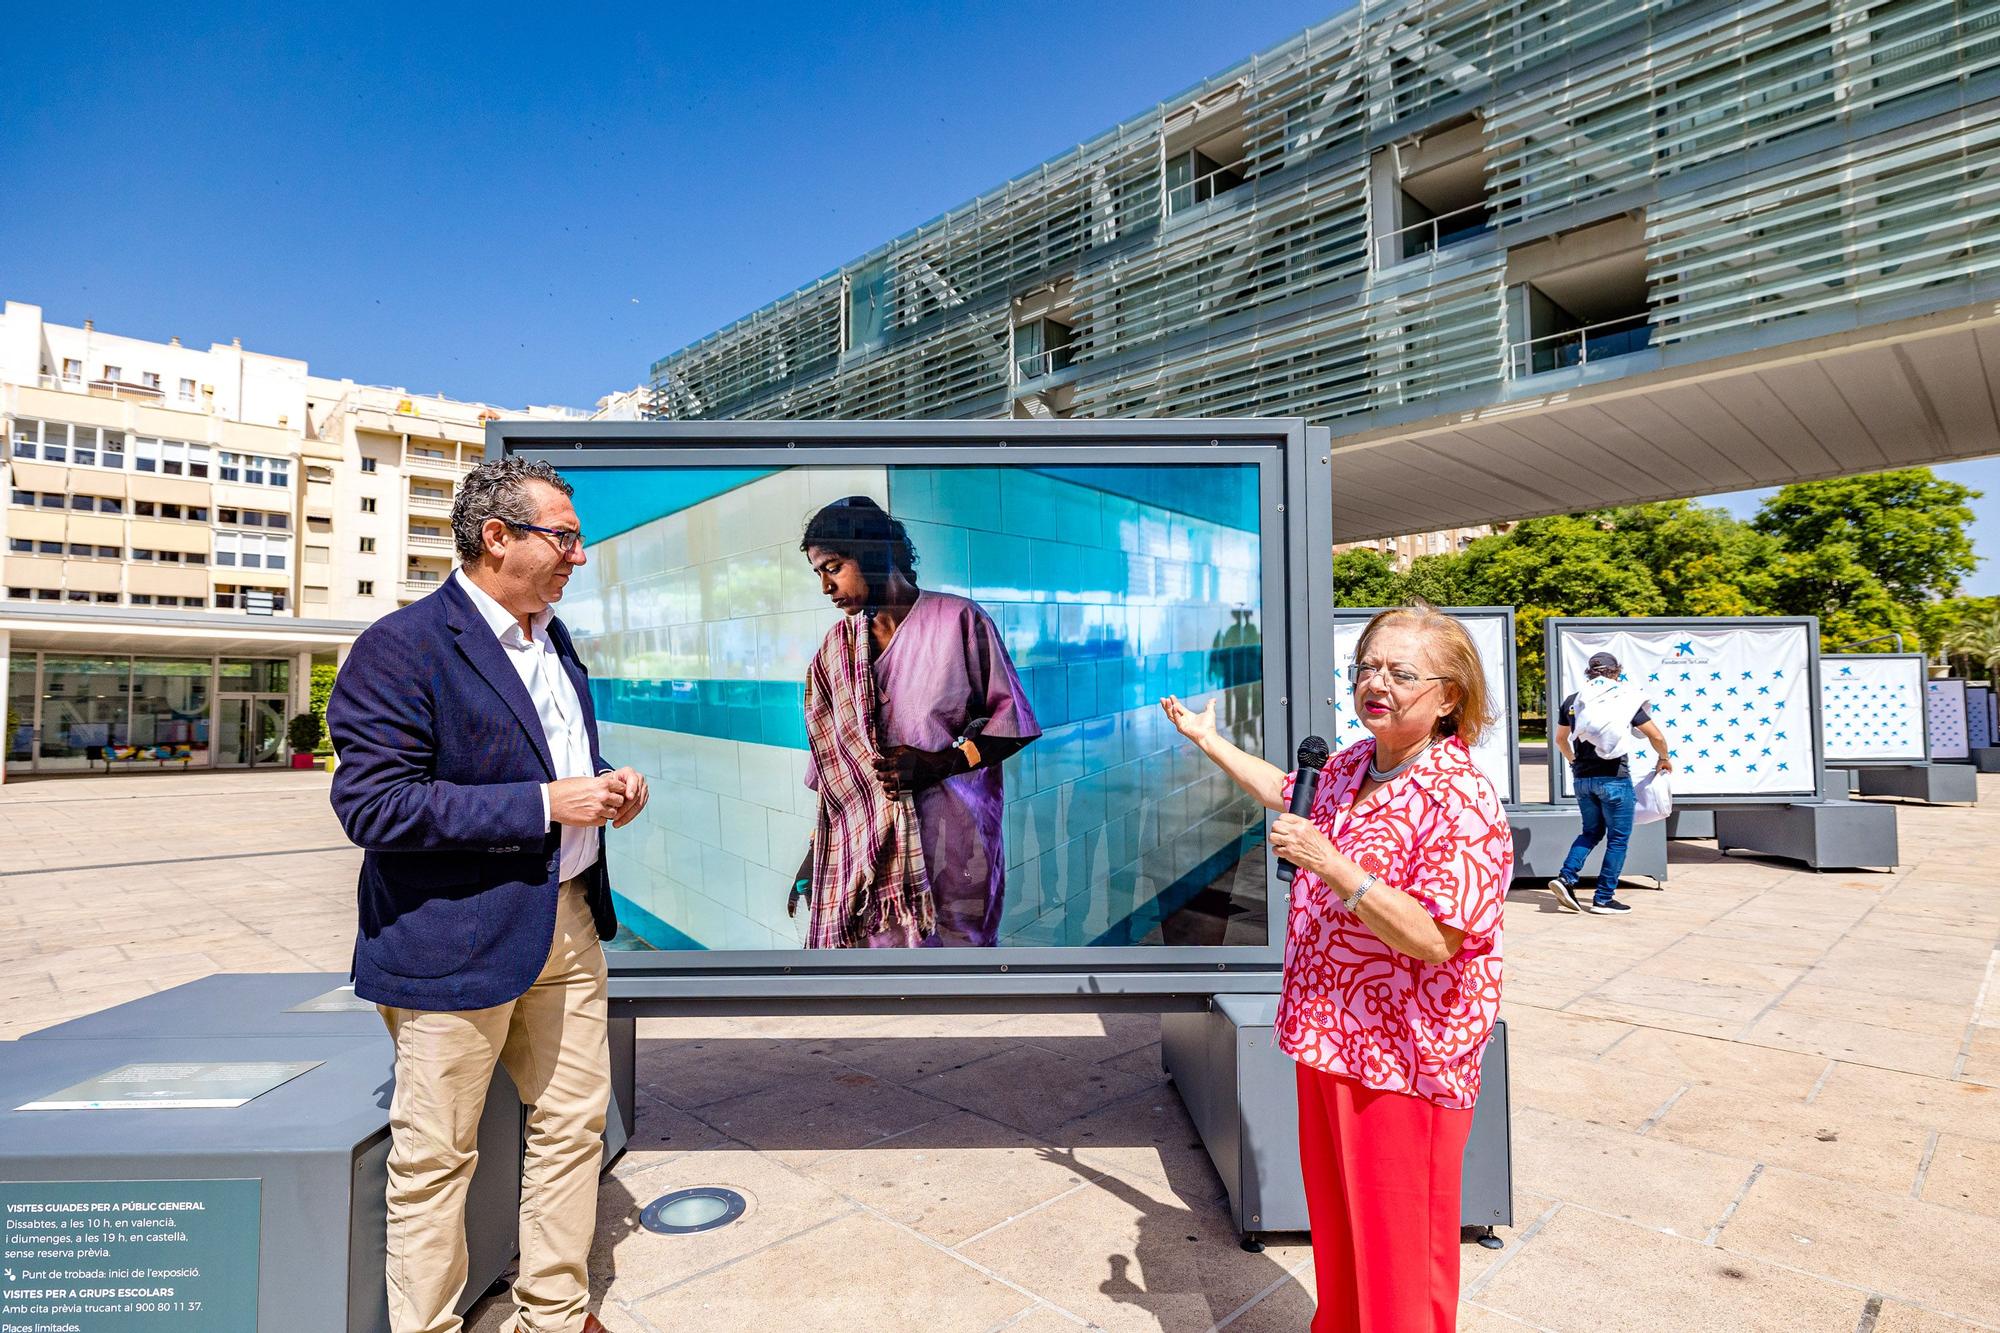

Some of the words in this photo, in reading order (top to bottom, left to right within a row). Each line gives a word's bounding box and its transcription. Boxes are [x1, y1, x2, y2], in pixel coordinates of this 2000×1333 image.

[7, 1204, 43, 1213] VISITES
[45, 1203, 89, 1212] GUIADES
[91, 1203, 110, 1212] PER
[112, 1203, 120, 1211] A
[122, 1201, 157, 1211] PÚBLIC
[158, 1202, 206, 1211] GENERAL
[6, 1219, 58, 1229] Dissabtes,
[70, 1219, 84, 1228] les
[88, 1219, 100, 1228] 10
[115, 1220, 128, 1228] en
[5, 1235, 9, 1243] i
[85, 1233, 99, 1242] les
[103, 1233, 115, 1242] 19
[130, 1234, 143, 1242] en
[5, 1249, 34, 1258] sense
[37, 1249, 74, 1258] reserva
[77, 1247, 111, 1259] prèvia.
[22, 1270, 46, 1279] Punt
[49, 1269, 62, 1279] de
[65, 1269, 106, 1279] trobada:
[109, 1268, 129, 1278] inici
[131, 1268, 145, 1278] de
[3, 1290, 43, 1299] VISITES
[45, 1289, 66, 1298] PER
[69, 1290, 77, 1298] A
[79, 1289, 115, 1298] GRUPS
[118, 1288, 174, 1297] ESCOLARS
[2, 1304, 28, 1314] Amb
[30, 1304, 49, 1313] cita
[51, 1303, 81, 1315] prèvia
[84, 1303, 121, 1312] trucant
[124, 1303, 133, 1312] al
[135, 1303, 155, 1312] 900
[157, 1302, 170, 1311] 80
[174, 1302, 184, 1311] 11
[188, 1302, 204, 1311] 37.
[2, 1324, 33, 1333] Places
[35, 1323, 81, 1333] limitades.
